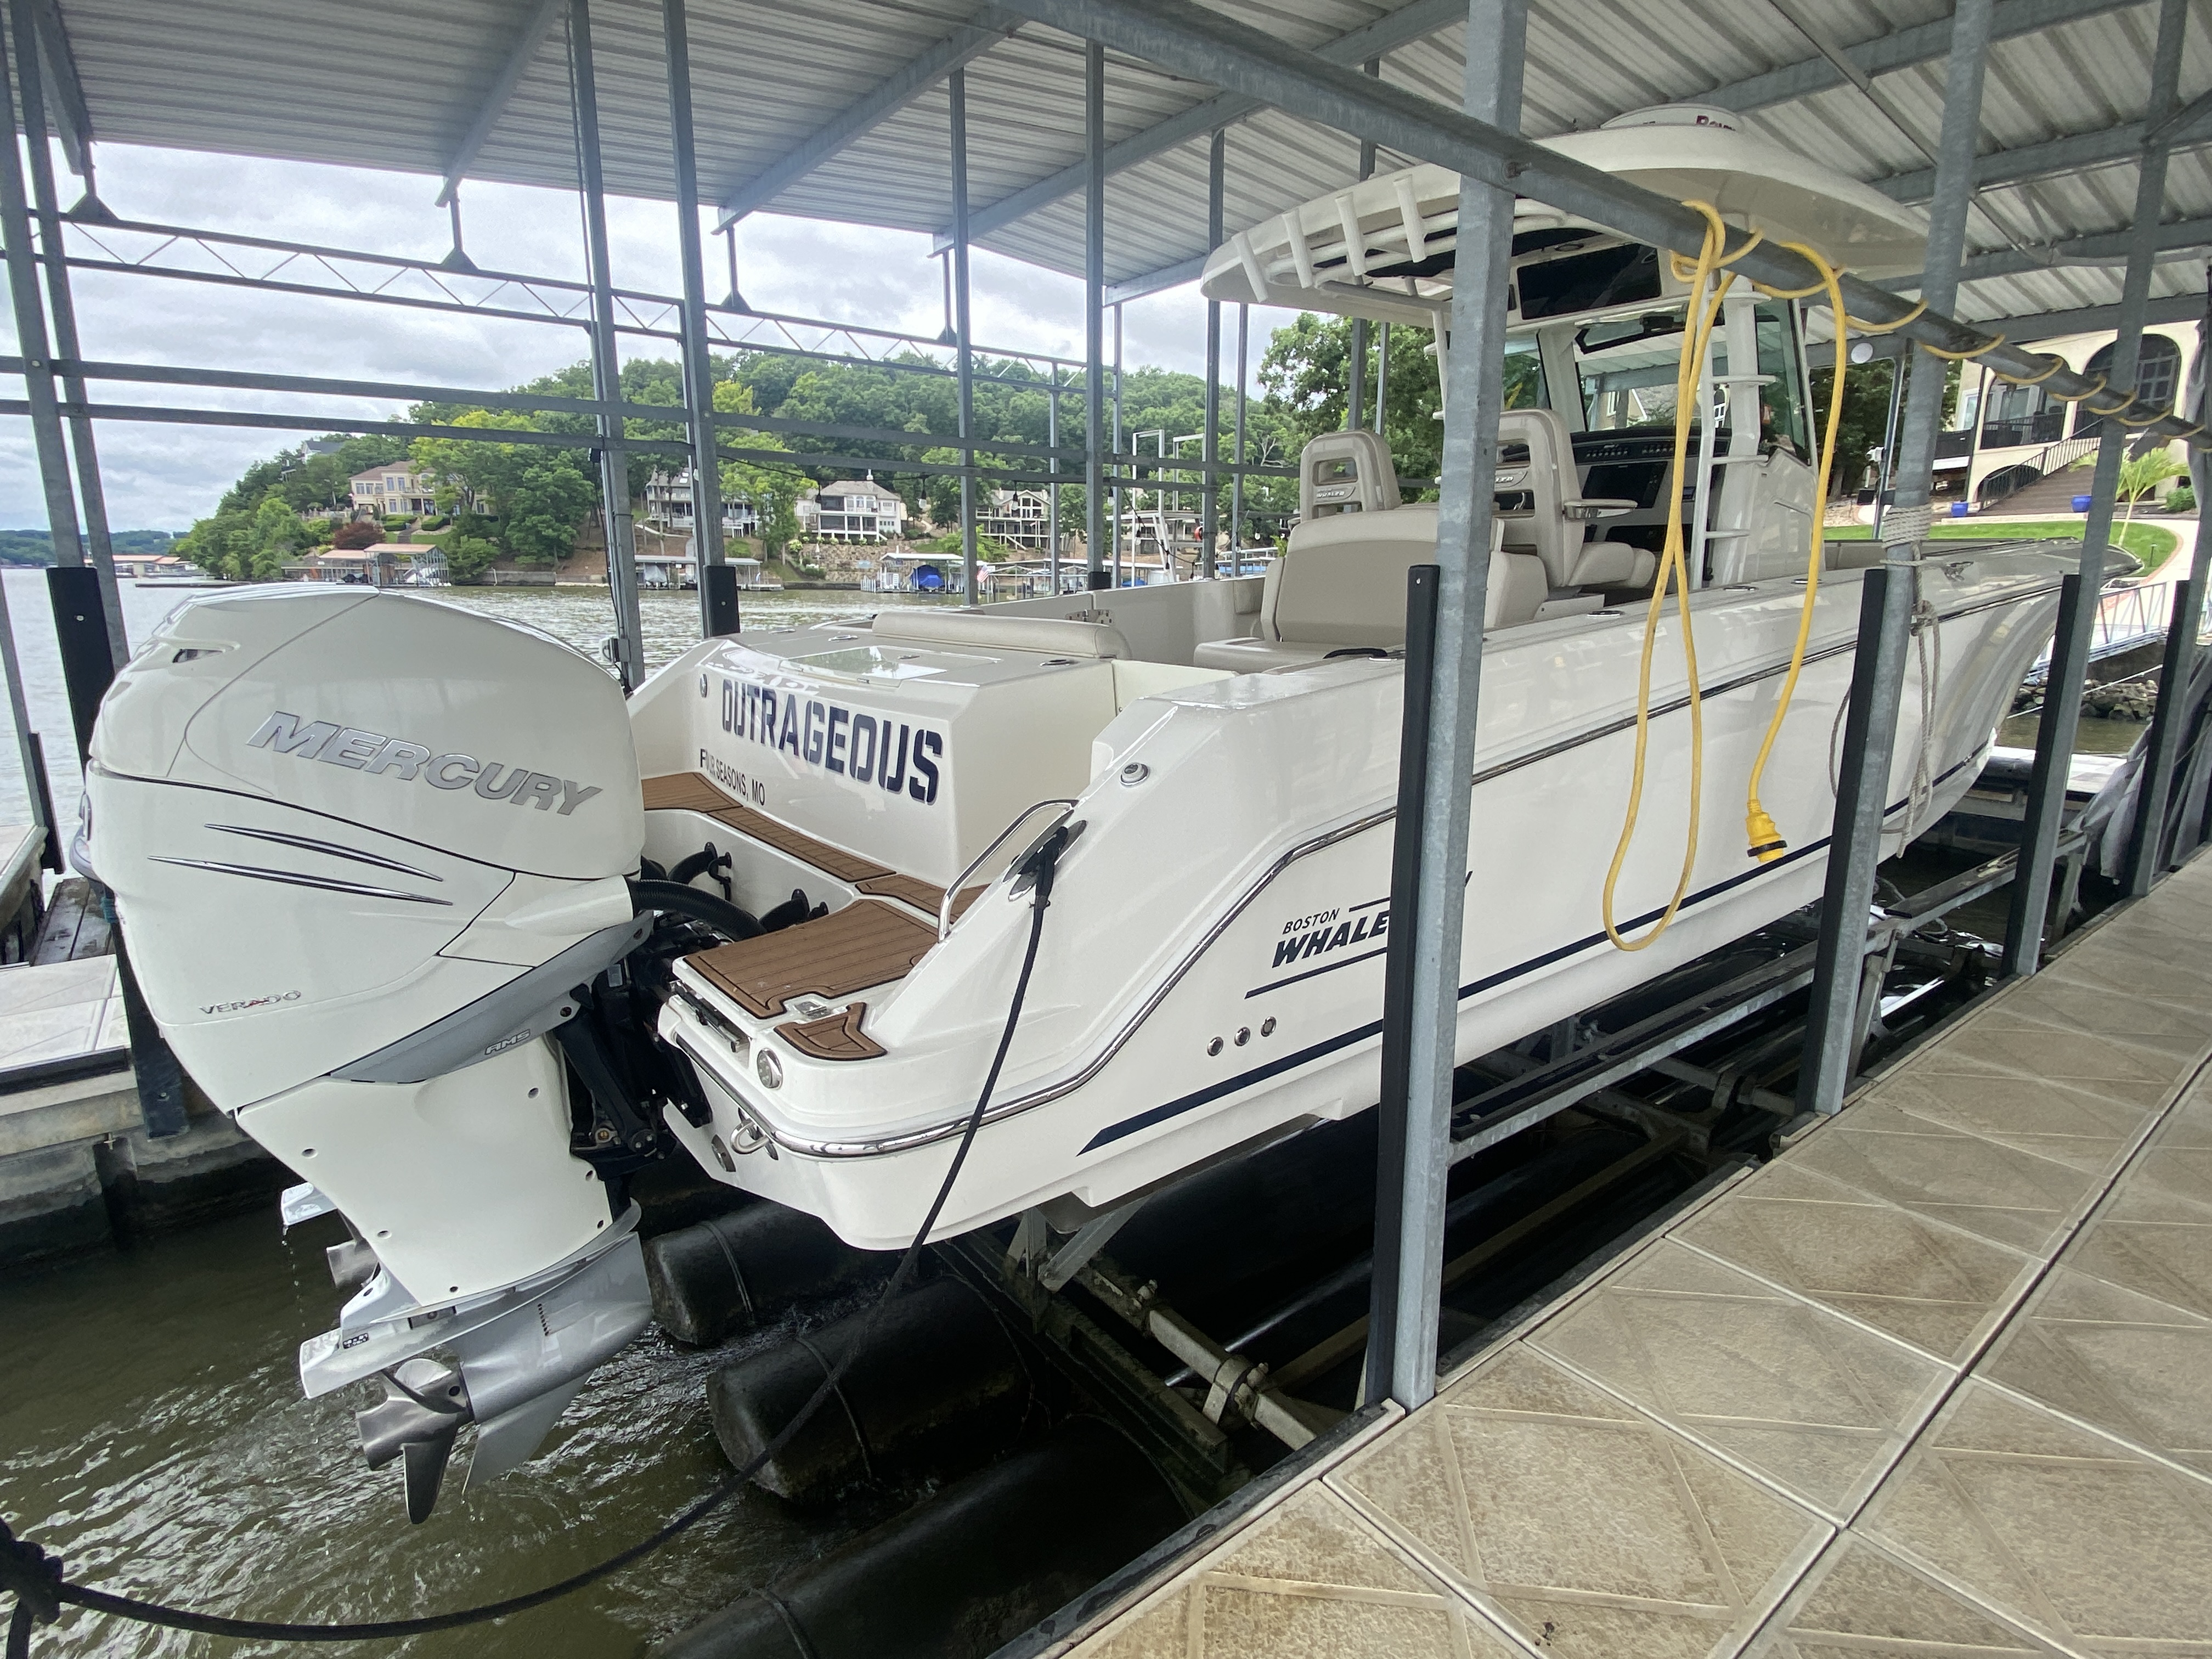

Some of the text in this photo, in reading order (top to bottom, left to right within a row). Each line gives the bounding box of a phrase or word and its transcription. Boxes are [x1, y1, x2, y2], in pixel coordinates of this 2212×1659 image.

[246, 710, 602, 816] MERCURY
[722, 679, 944, 805] OUTRAGEOUS
[716, 758, 748, 802] SEASONS,
[752, 778, 765, 806] MO
[1272, 910, 1390, 968] WHALE
[1282, 907, 1340, 935] BOSTON
[199, 990, 302, 1014] VERADO
[484, 1029, 531, 1055] AMS
